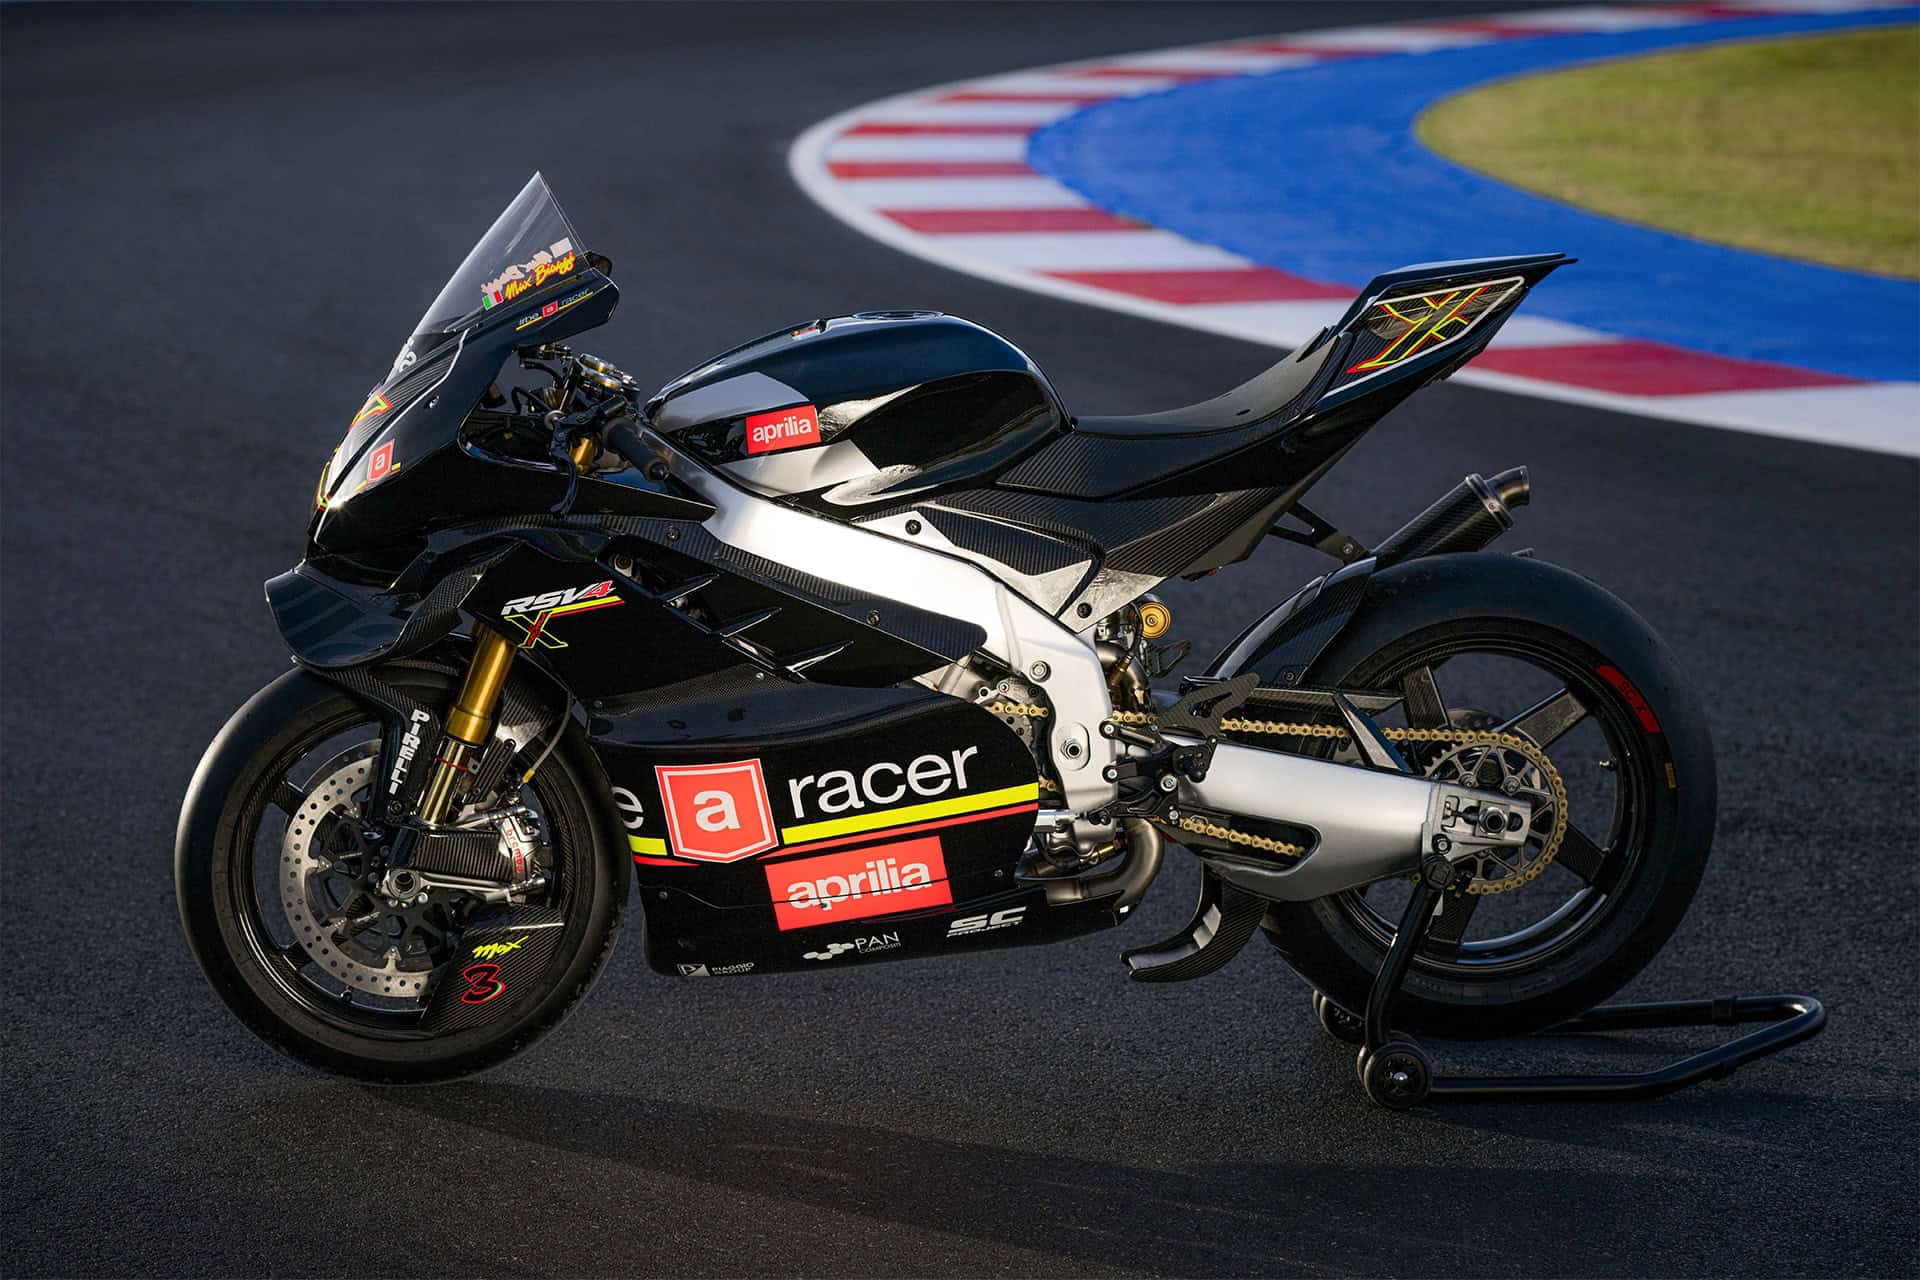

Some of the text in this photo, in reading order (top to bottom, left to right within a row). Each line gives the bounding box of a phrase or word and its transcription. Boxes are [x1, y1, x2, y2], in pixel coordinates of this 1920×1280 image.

[752, 415, 812, 444] aprilia
[501, 580, 616, 616] RSV4
[389, 709, 430, 795] PIRELLI
[692, 789, 741, 832] a
[788, 745, 979, 819] racer
[787, 857, 932, 911] aprilia
[855, 931, 900, 949] PAN
[460, 963, 506, 1004] 3
